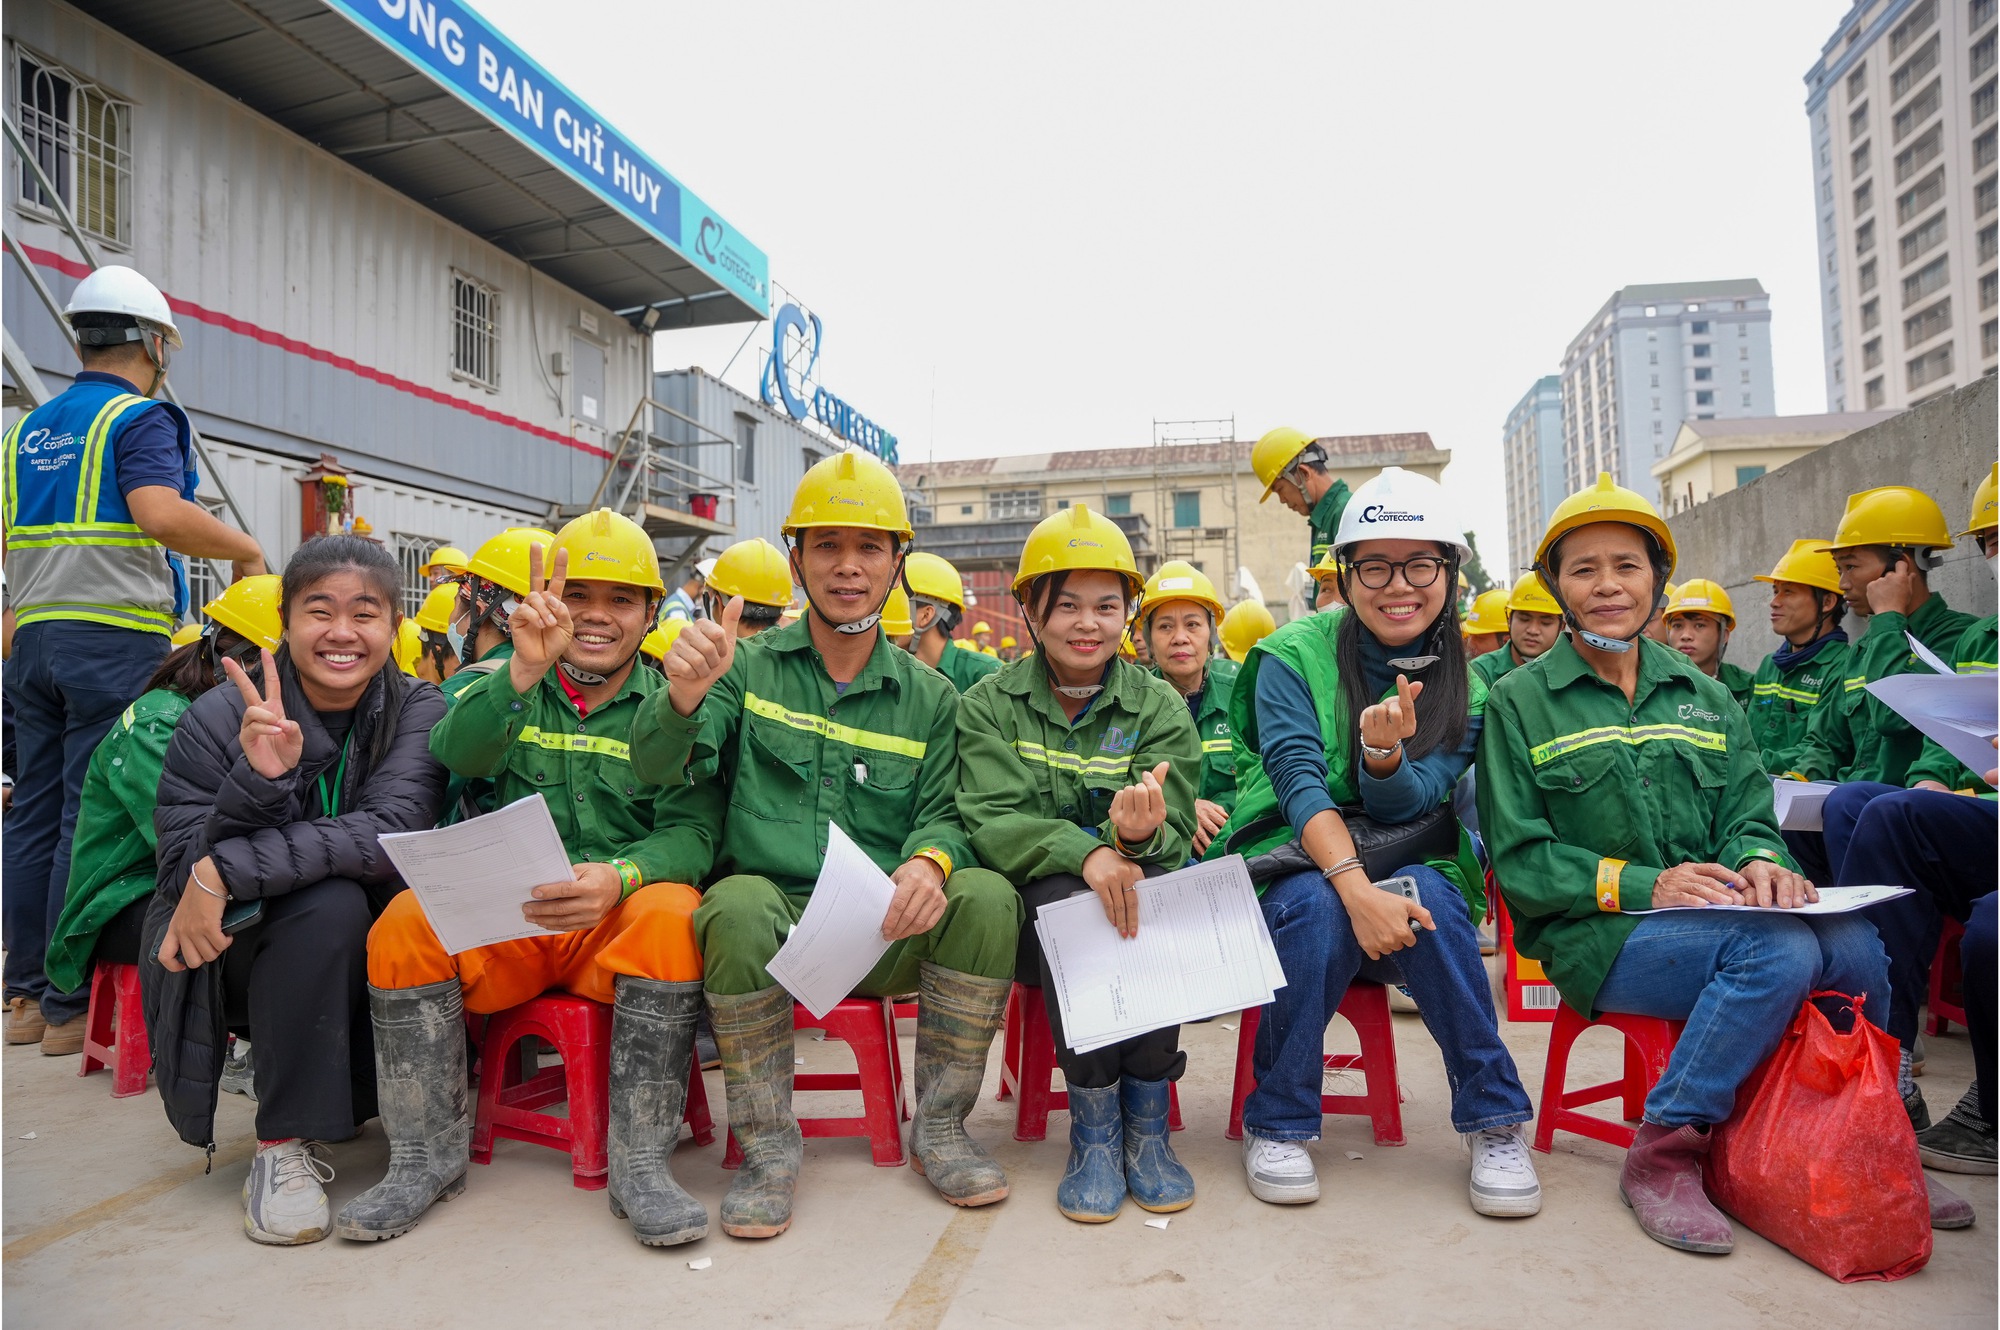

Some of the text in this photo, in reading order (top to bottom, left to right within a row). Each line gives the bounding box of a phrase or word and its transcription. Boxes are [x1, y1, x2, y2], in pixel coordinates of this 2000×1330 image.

[478, 42, 544, 131] BAN
[553, 107, 605, 176] CHỈ
[613, 150, 661, 215] HUY
